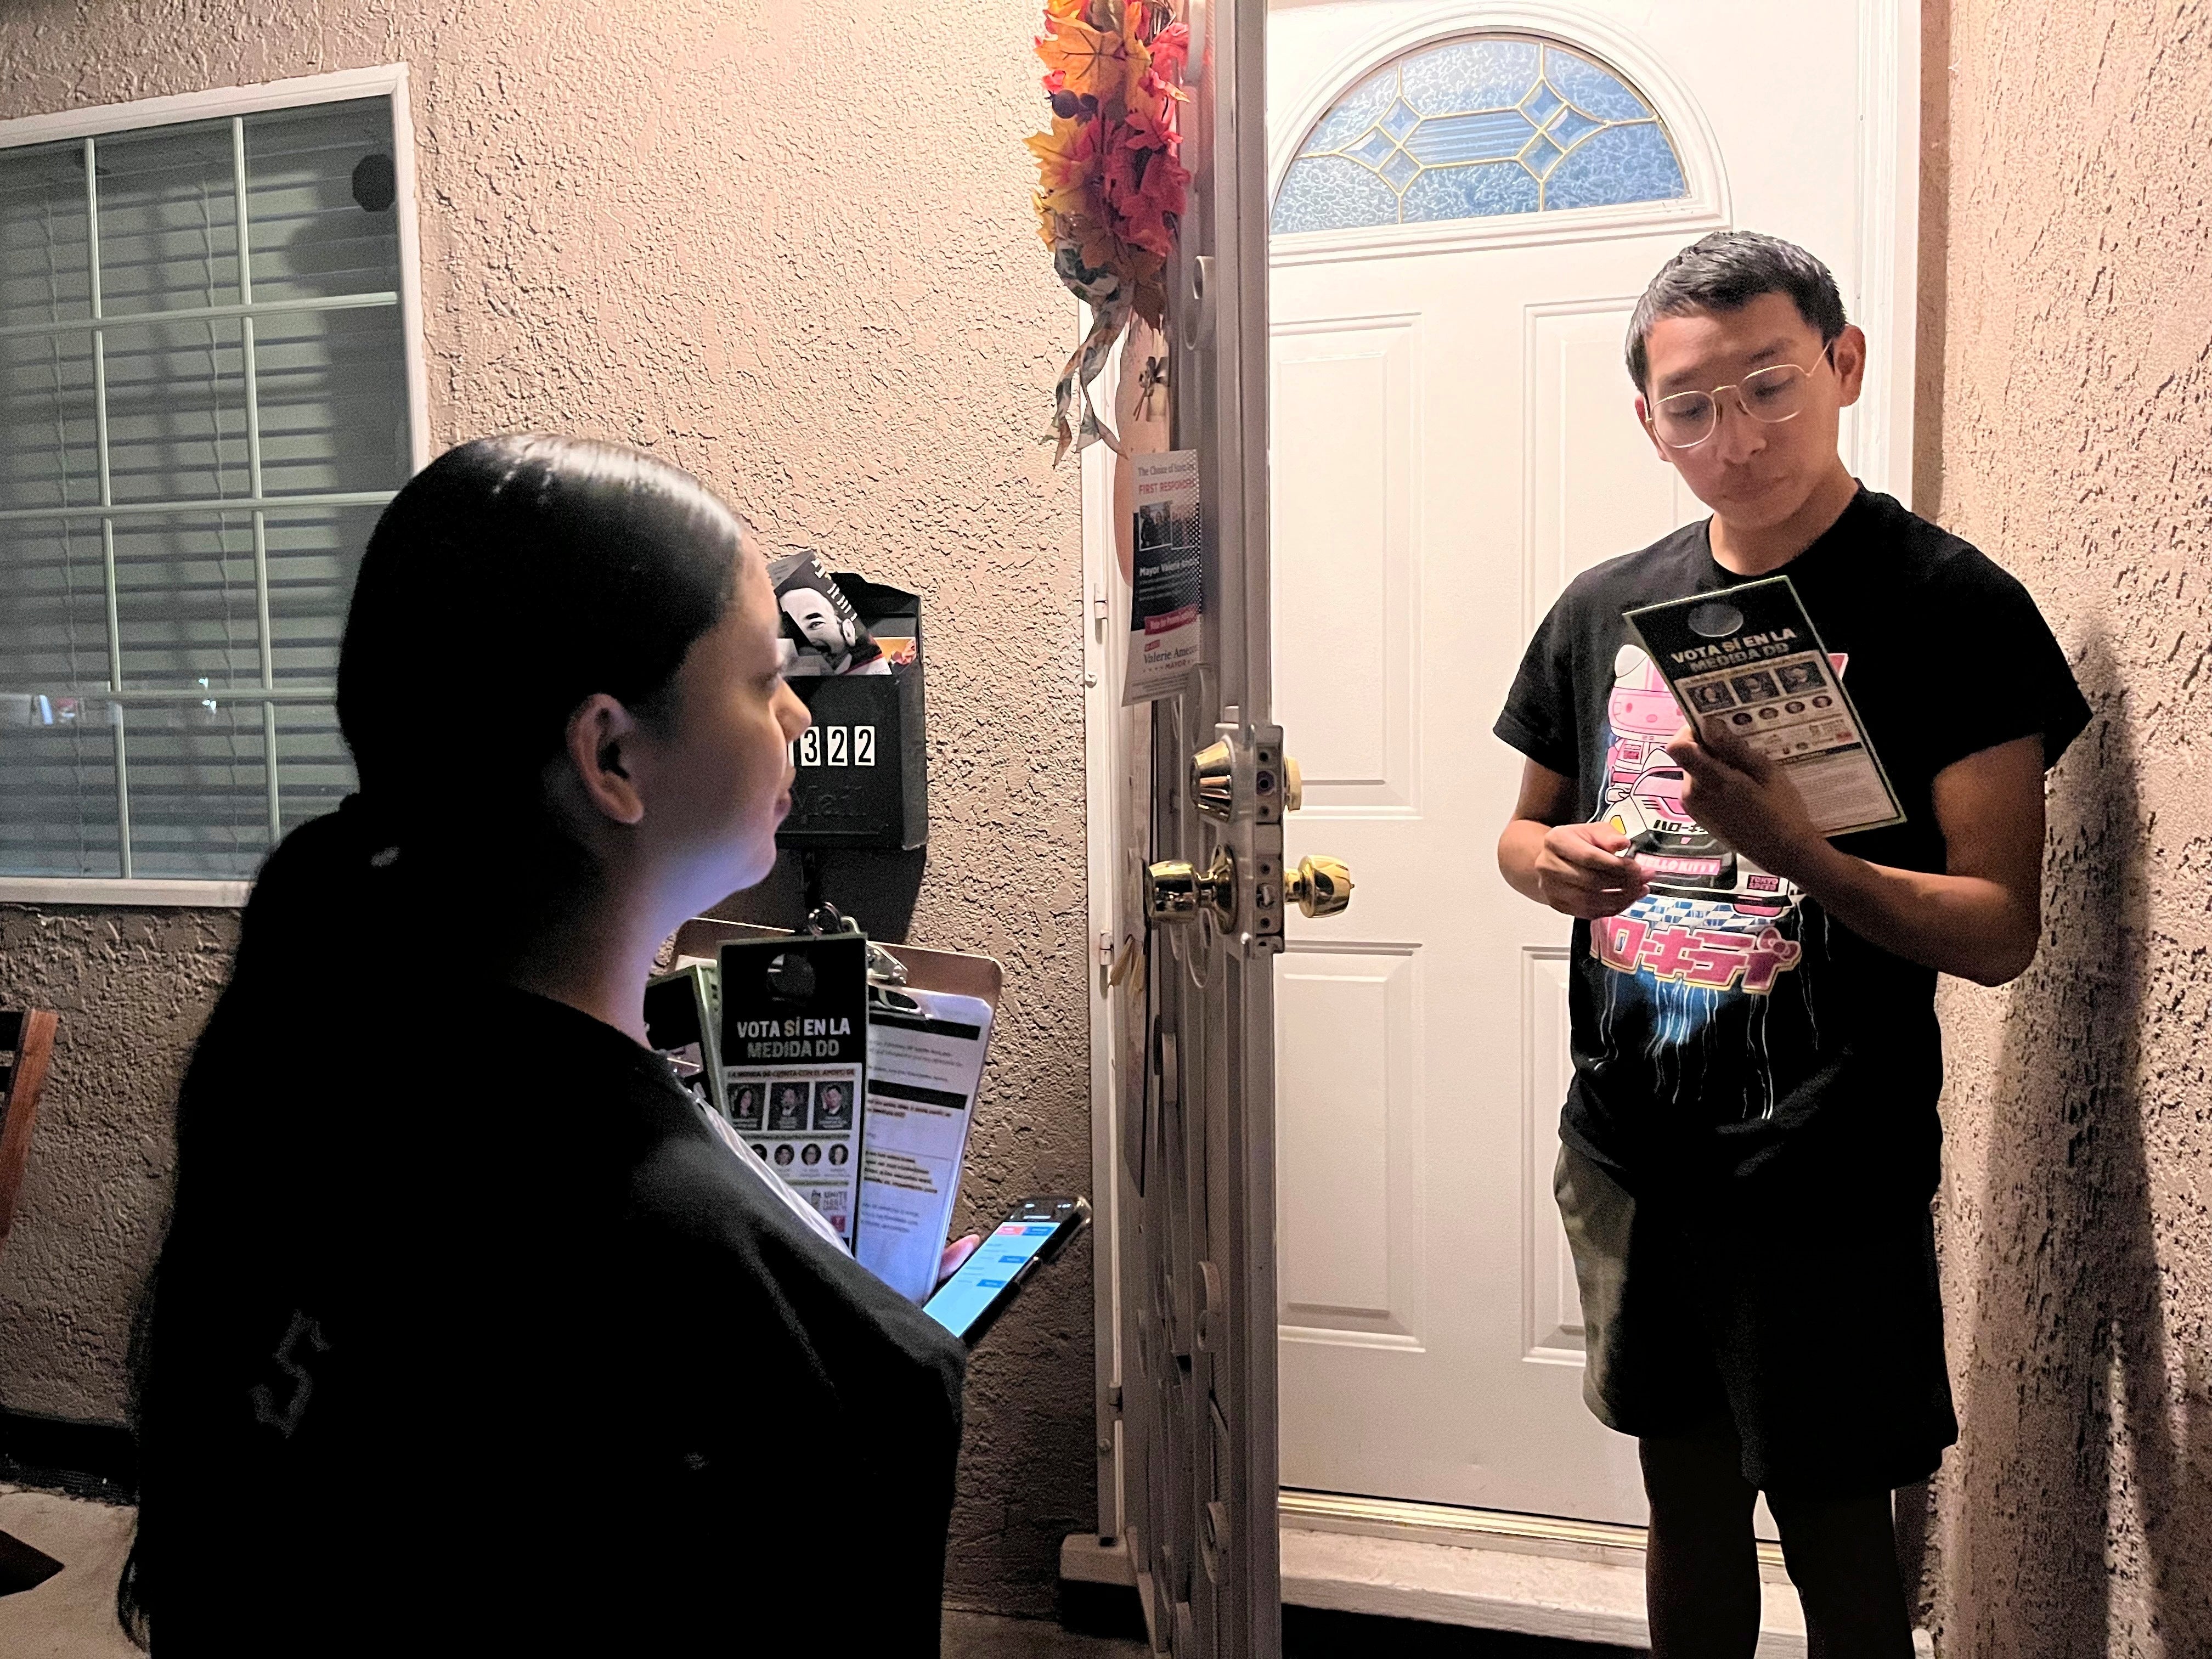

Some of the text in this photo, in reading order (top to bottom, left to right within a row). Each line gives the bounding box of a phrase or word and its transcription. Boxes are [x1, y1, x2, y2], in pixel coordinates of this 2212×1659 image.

[1139, 483, 1158, 495] FIRST
[1139, 566, 1160, 577] Mayor
[1671, 644, 1722, 663] VOTA
[1742, 633, 1769, 647] EN
[1769, 628, 1797, 641] LA
[1143, 650, 1171, 663] Valerie
[1689, 649, 1762, 672] MEDIDA
[1762, 642, 1790, 657] DD
[1165, 659, 1186, 669] MAYOR
[803, 729, 872, 763] 322
[1678, 861, 1718, 873] KITTY
[1748, 882, 1776, 891] SPEED
[1750, 876, 1779, 885] TOKYO
[737, 1016, 851, 1039] VOTA SÍ EN LA
[747, 1039, 840, 1058] MEDIDA DD
